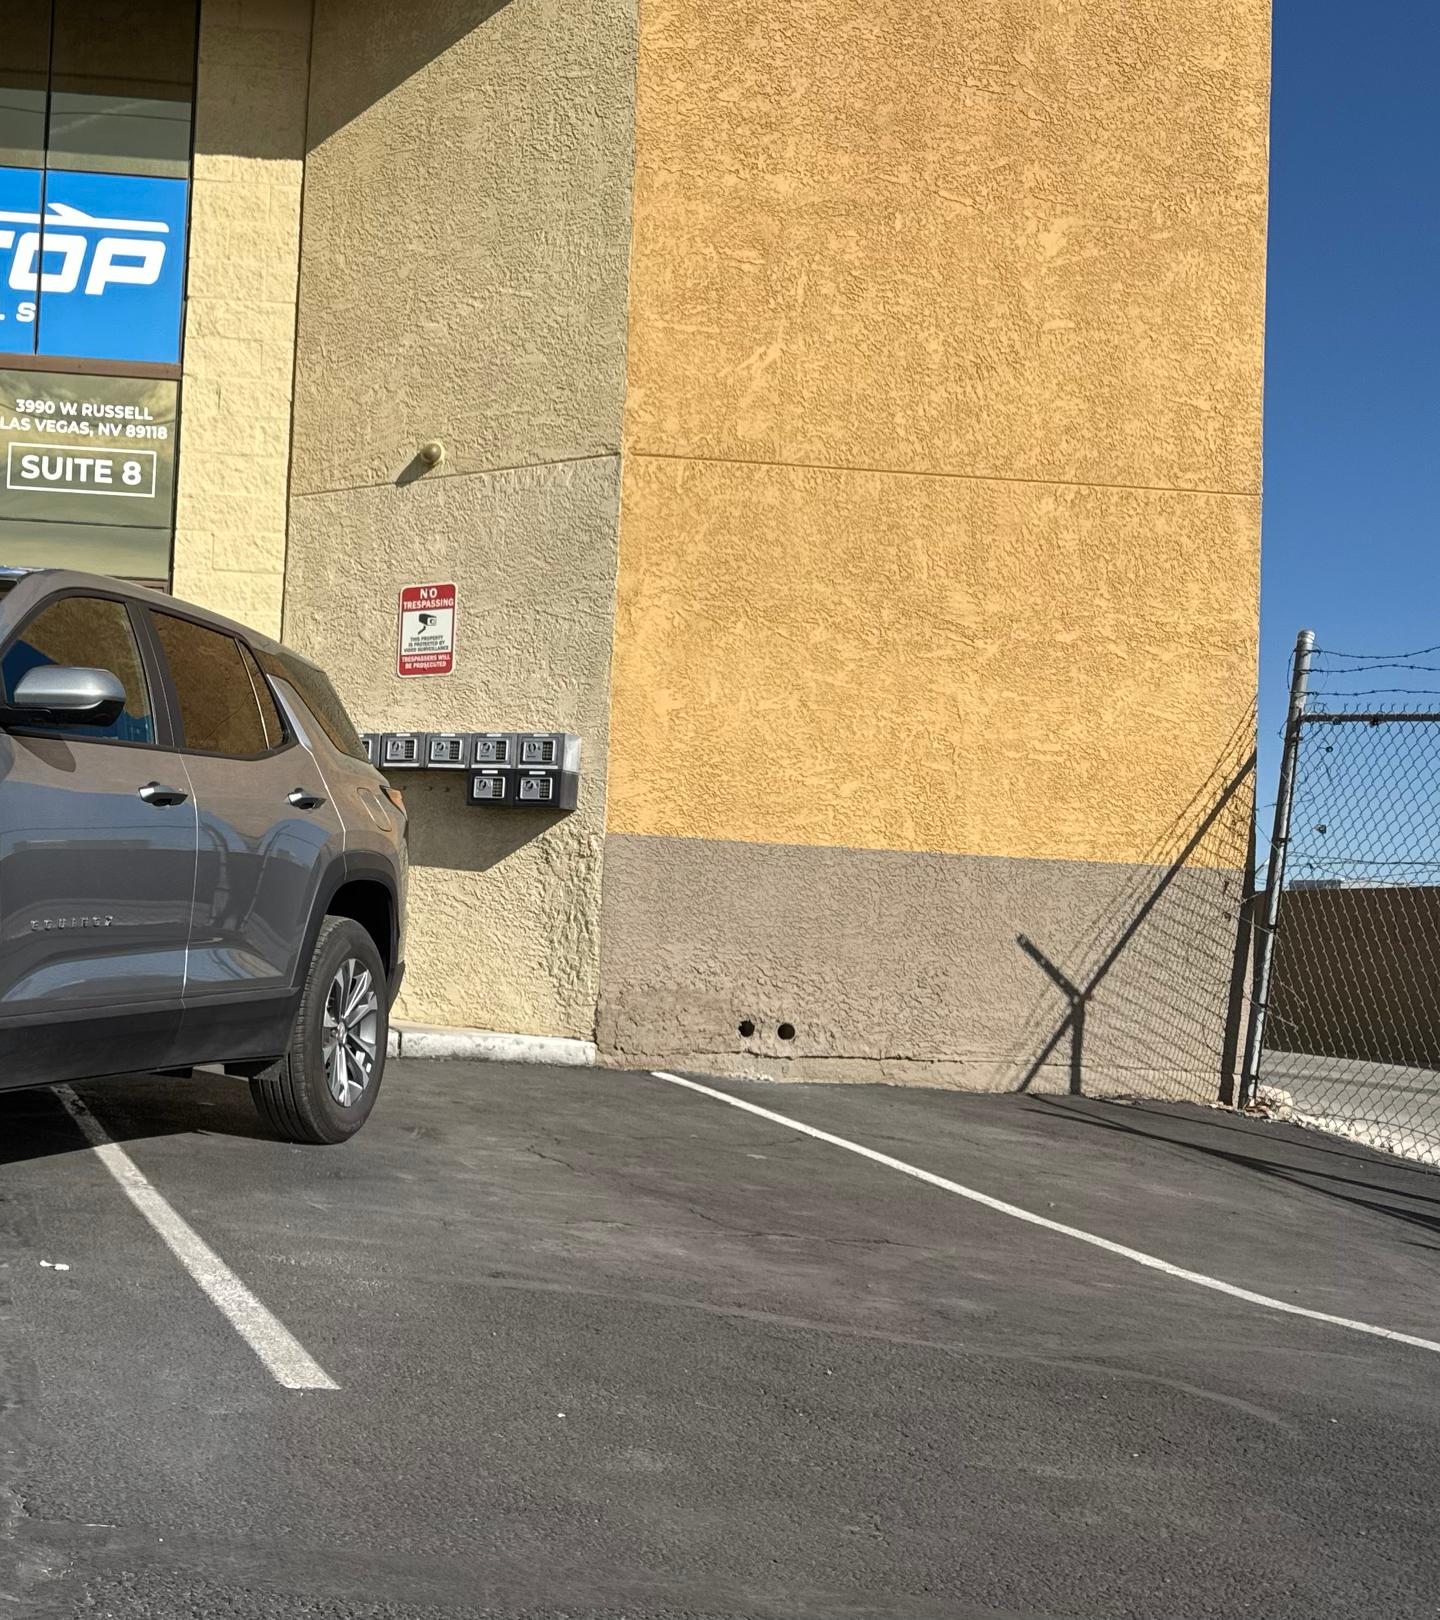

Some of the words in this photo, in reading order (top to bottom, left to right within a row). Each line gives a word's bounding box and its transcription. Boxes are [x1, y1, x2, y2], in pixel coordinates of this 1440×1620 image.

[15, 399, 56, 415] 3990
[60, 402, 77, 416] W.
[81, 404, 154, 421] RUSSELL
[0, 416, 32, 432] LAS
[34, 418, 94, 437] VEGAS,
[98, 423, 123, 437] NV
[125, 424, 168, 440] 89118
[20, 454, 114, 484] SUITE
[121, 460, 142, 486] 8
[420, 588, 437, 599] NO
[403, 598, 453, 609] TRESPASSING
[413, 661, 446, 669] PROSECUTED
